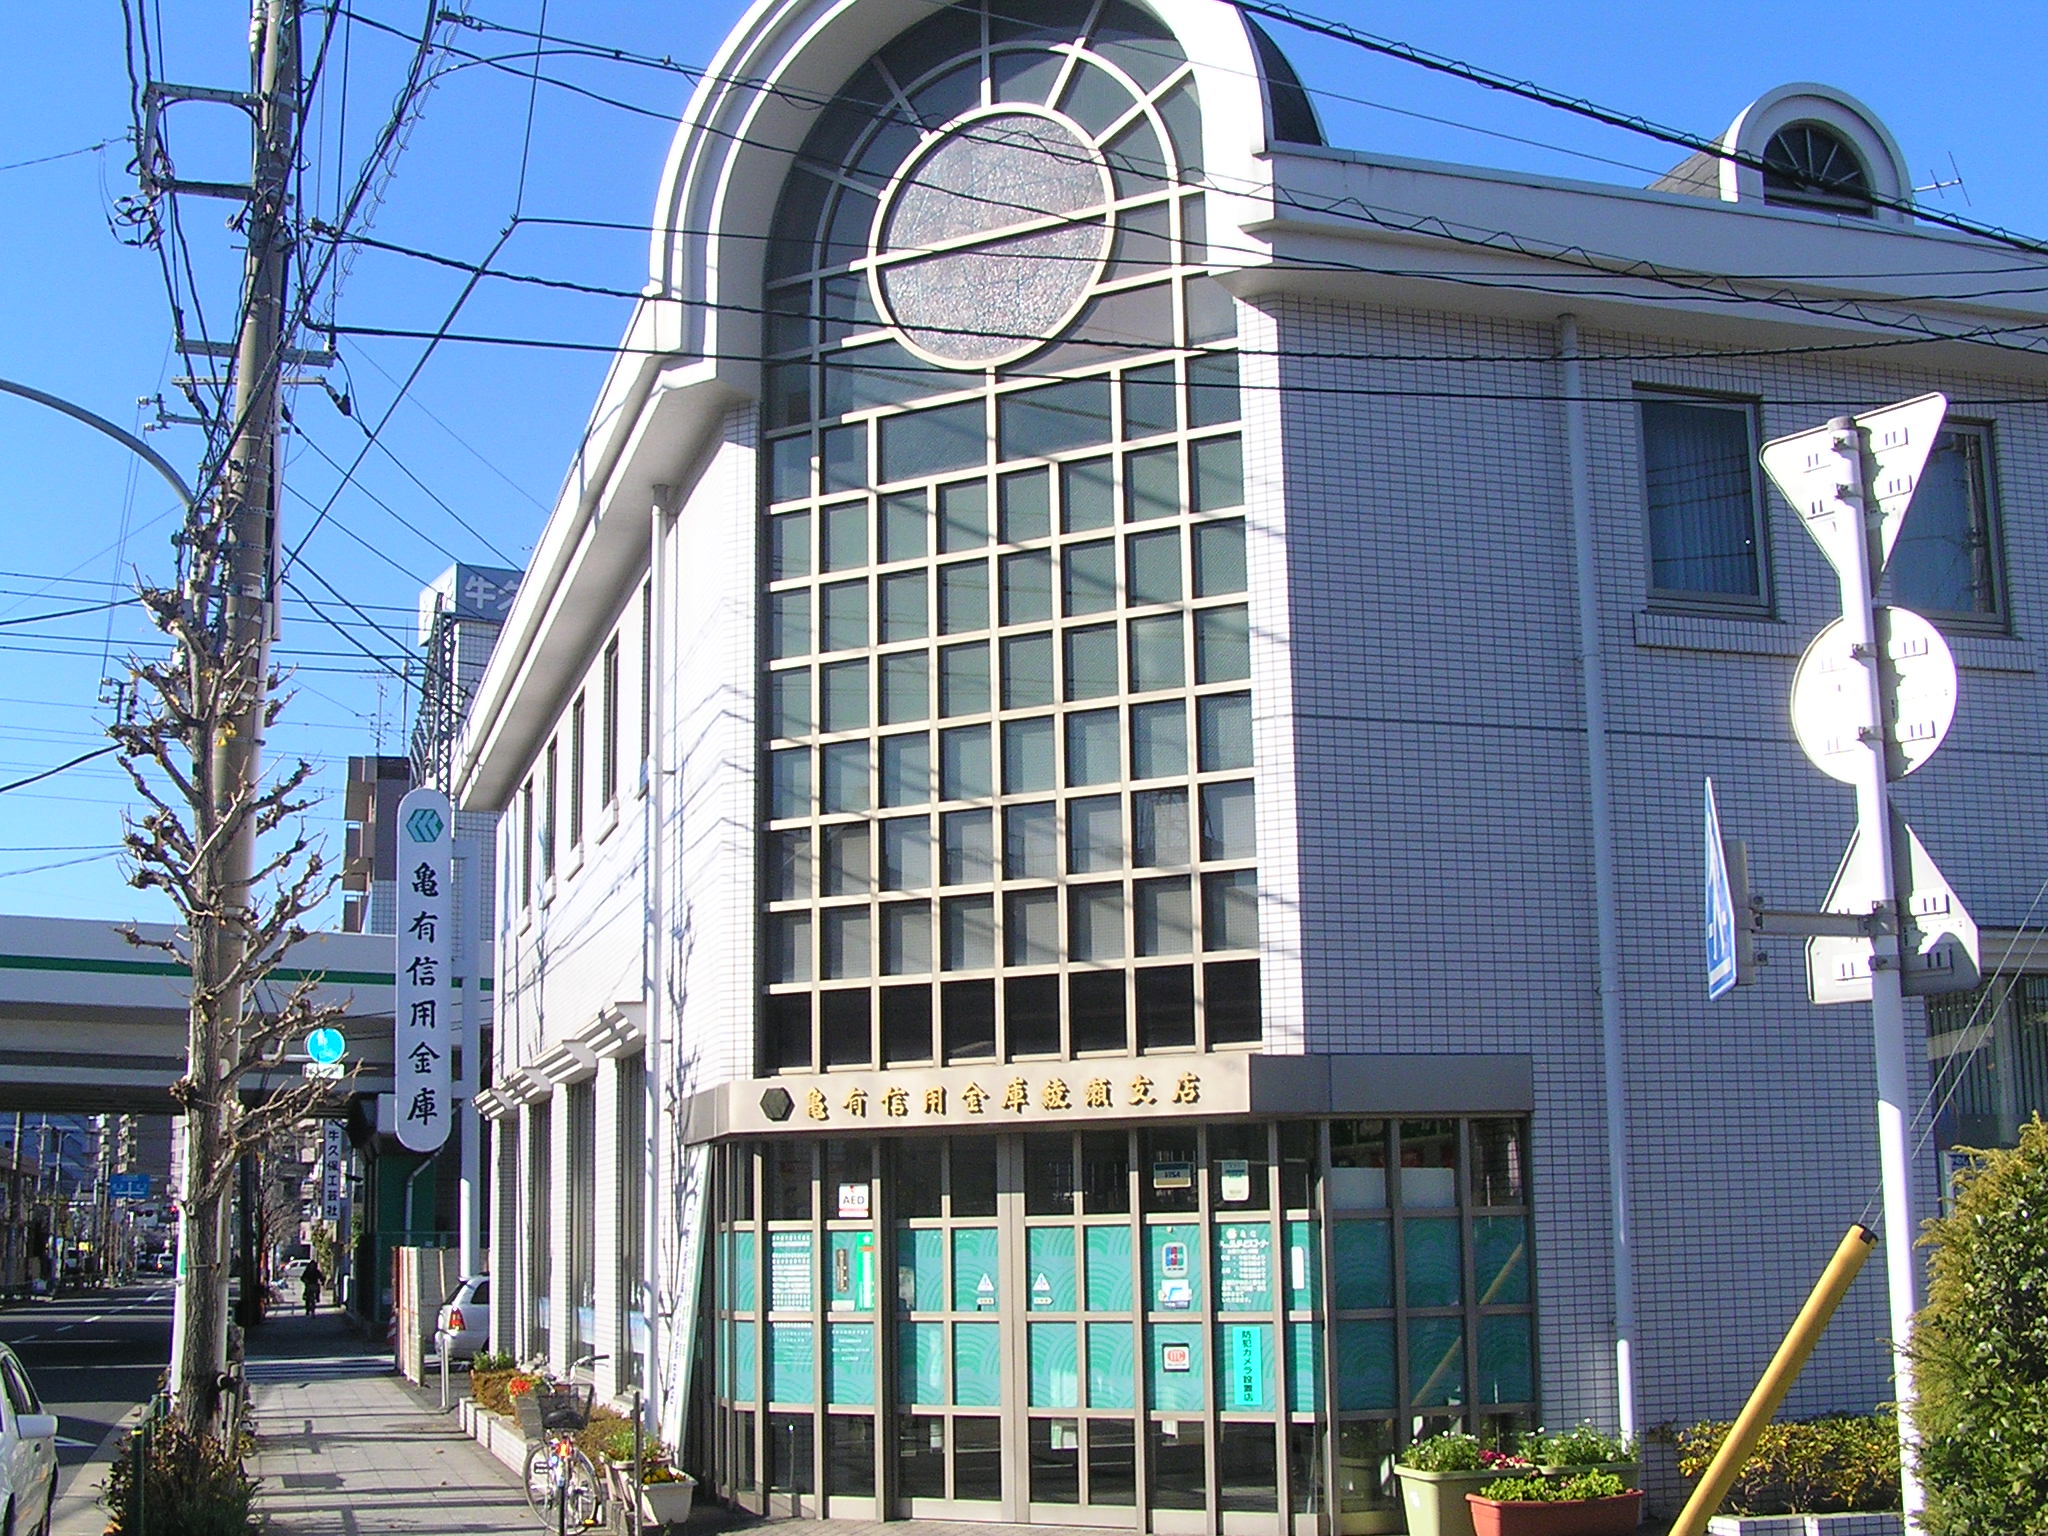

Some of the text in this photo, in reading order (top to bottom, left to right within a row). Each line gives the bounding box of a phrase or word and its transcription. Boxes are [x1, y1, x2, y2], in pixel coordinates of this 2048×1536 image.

[405, 862, 440, 1127] 亀有信用金庫
[806, 1071, 1201, 1122] 亀有信用金庫綾瀬支店
[843, 1195, 865, 1205] AED
[1241, 1330, 1254, 1402] 防犯カメラ設置店
